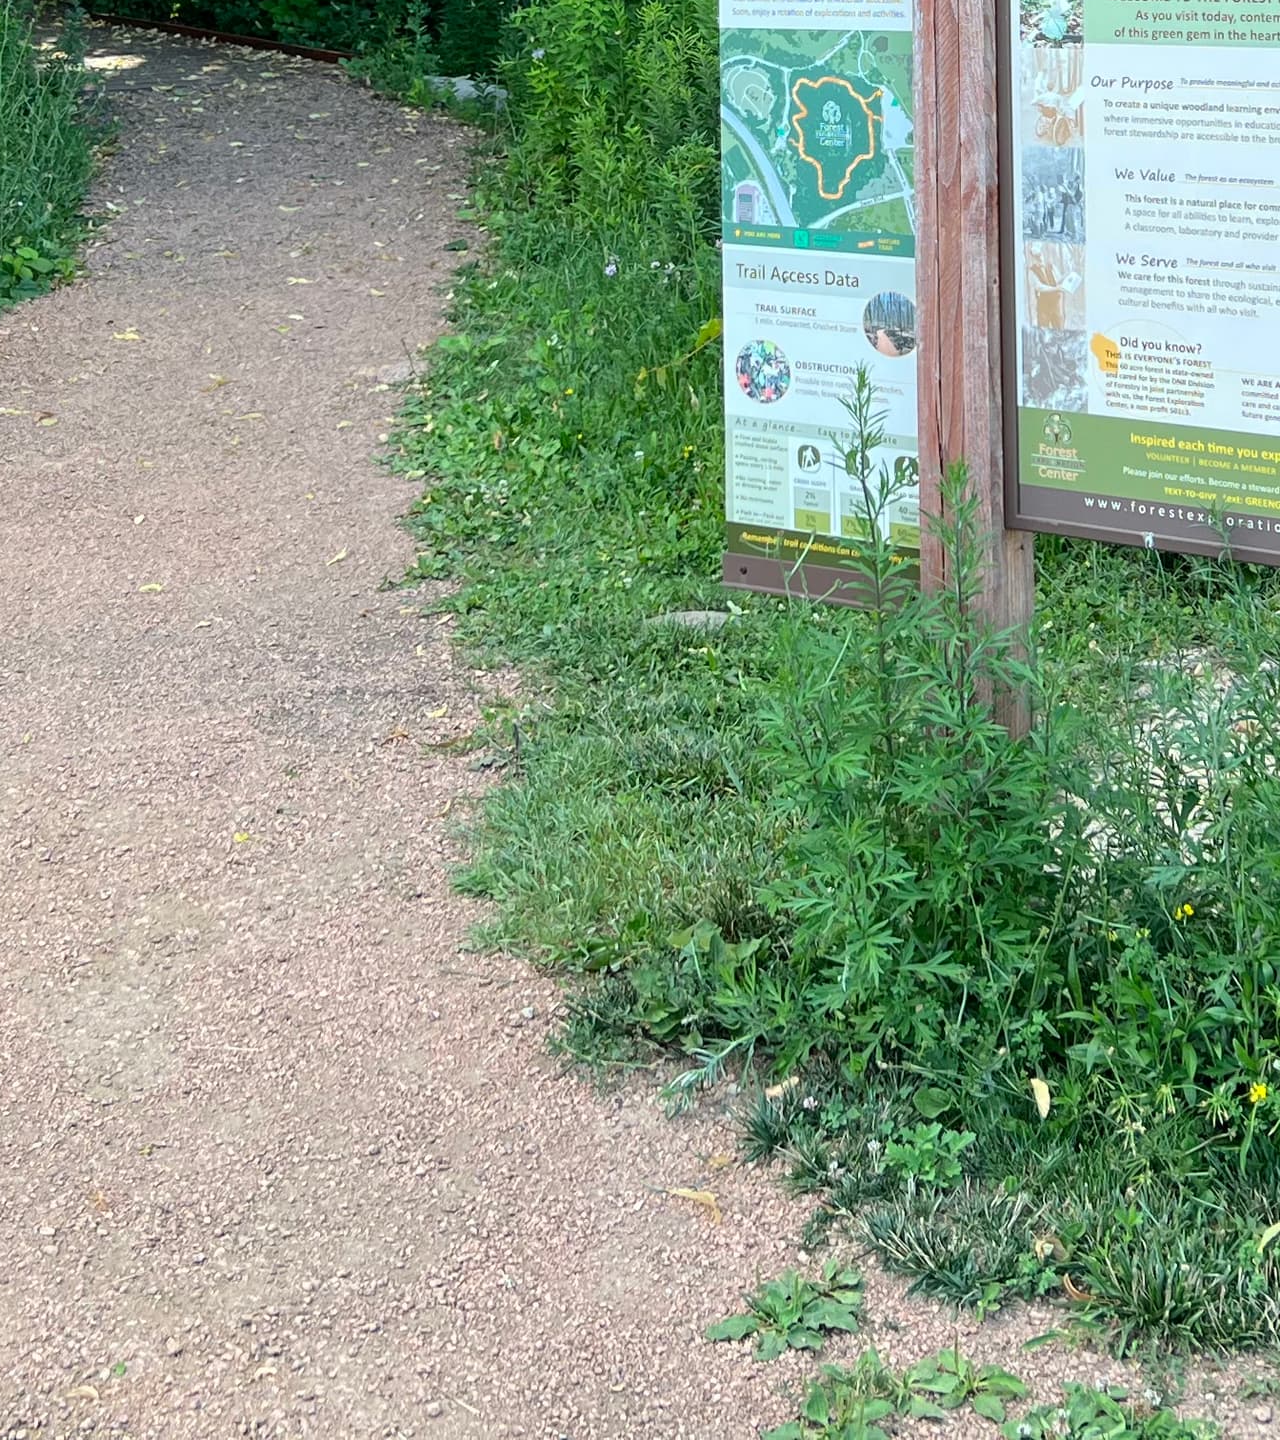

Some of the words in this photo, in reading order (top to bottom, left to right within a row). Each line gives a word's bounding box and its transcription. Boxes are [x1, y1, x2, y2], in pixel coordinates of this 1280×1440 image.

[1135, 11, 1148, 20] As
[1152, 12, 1171, 23] you
[1175, 11, 1198, 21] visit
[1202, 12, 1237, 23] today,
[1090, 76, 1116, 88] Our
[1121, 76, 1173, 93] Purpose
[1114, 168, 1134, 180] We
[1140, 169, 1176, 183] Value
[1116, 253, 1135, 266] We
[1141, 255, 1178, 268] Serve
[736, 263, 765, 280] Trail
[771, 266, 819, 284] Access
[825, 271, 859, 288] Data
[755, 304, 778, 314] TRAIL
[780, 306, 816, 316] SURFACE
[1120, 337, 1138, 348] Did
[1142, 340, 1161, 351] you
[1166, 339, 1202, 354] know?
[1131, 433, 1175, 448] Inspired
[1178, 440, 1204, 451] each
[1208, 442, 1234, 455] time
[1237, 447, 1258, 458] you
